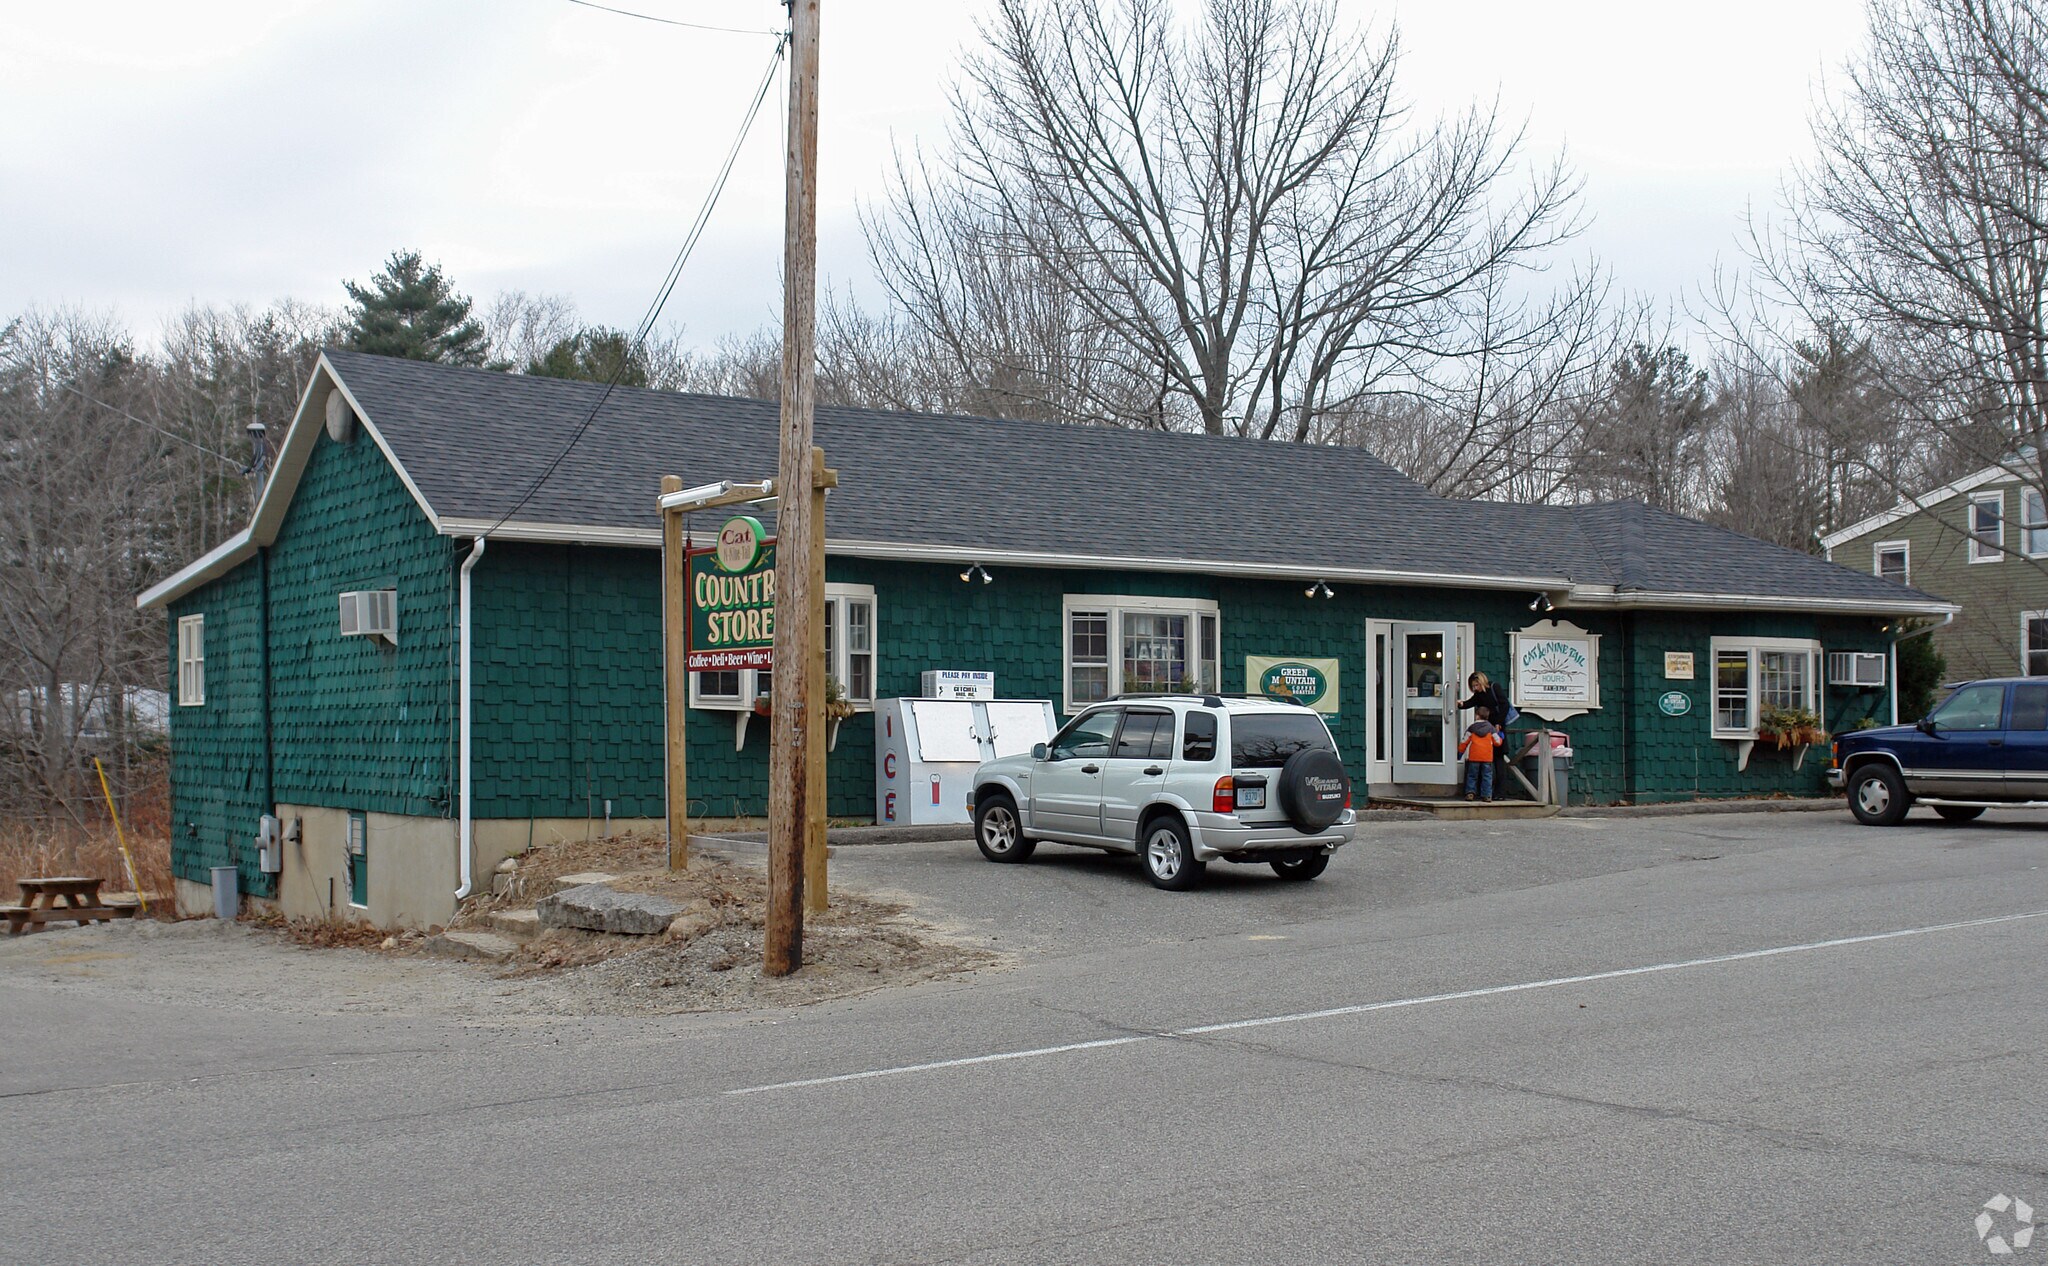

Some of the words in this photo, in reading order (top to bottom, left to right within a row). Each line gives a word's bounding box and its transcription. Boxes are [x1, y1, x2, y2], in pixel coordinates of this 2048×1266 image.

[722, 529, 751, 544] Cat
[695, 569, 775, 608] COUNTR
[708, 608, 774, 643] STORE
[689, 654, 709, 667] Coffee
[712, 653, 725, 666] Deli
[728, 653, 744, 666] Beer
[747, 651, 764, 664] Wine
[1138, 643, 1176, 660] ATM
[1523, 646, 1537, 666] CAT
[1546, 642, 1569, 655] NINE
[1569, 647, 1585, 667] TAIL
[942, 671, 960, 679] PLEASE
[961, 672, 971, 680] PAY
[1281, 668, 1308, 676] GREEN
[1542, 675, 1566, 683] HOURS
[1315, 782, 1342, 791] VITARA
[1244, 791, 1258, 801] 8370
